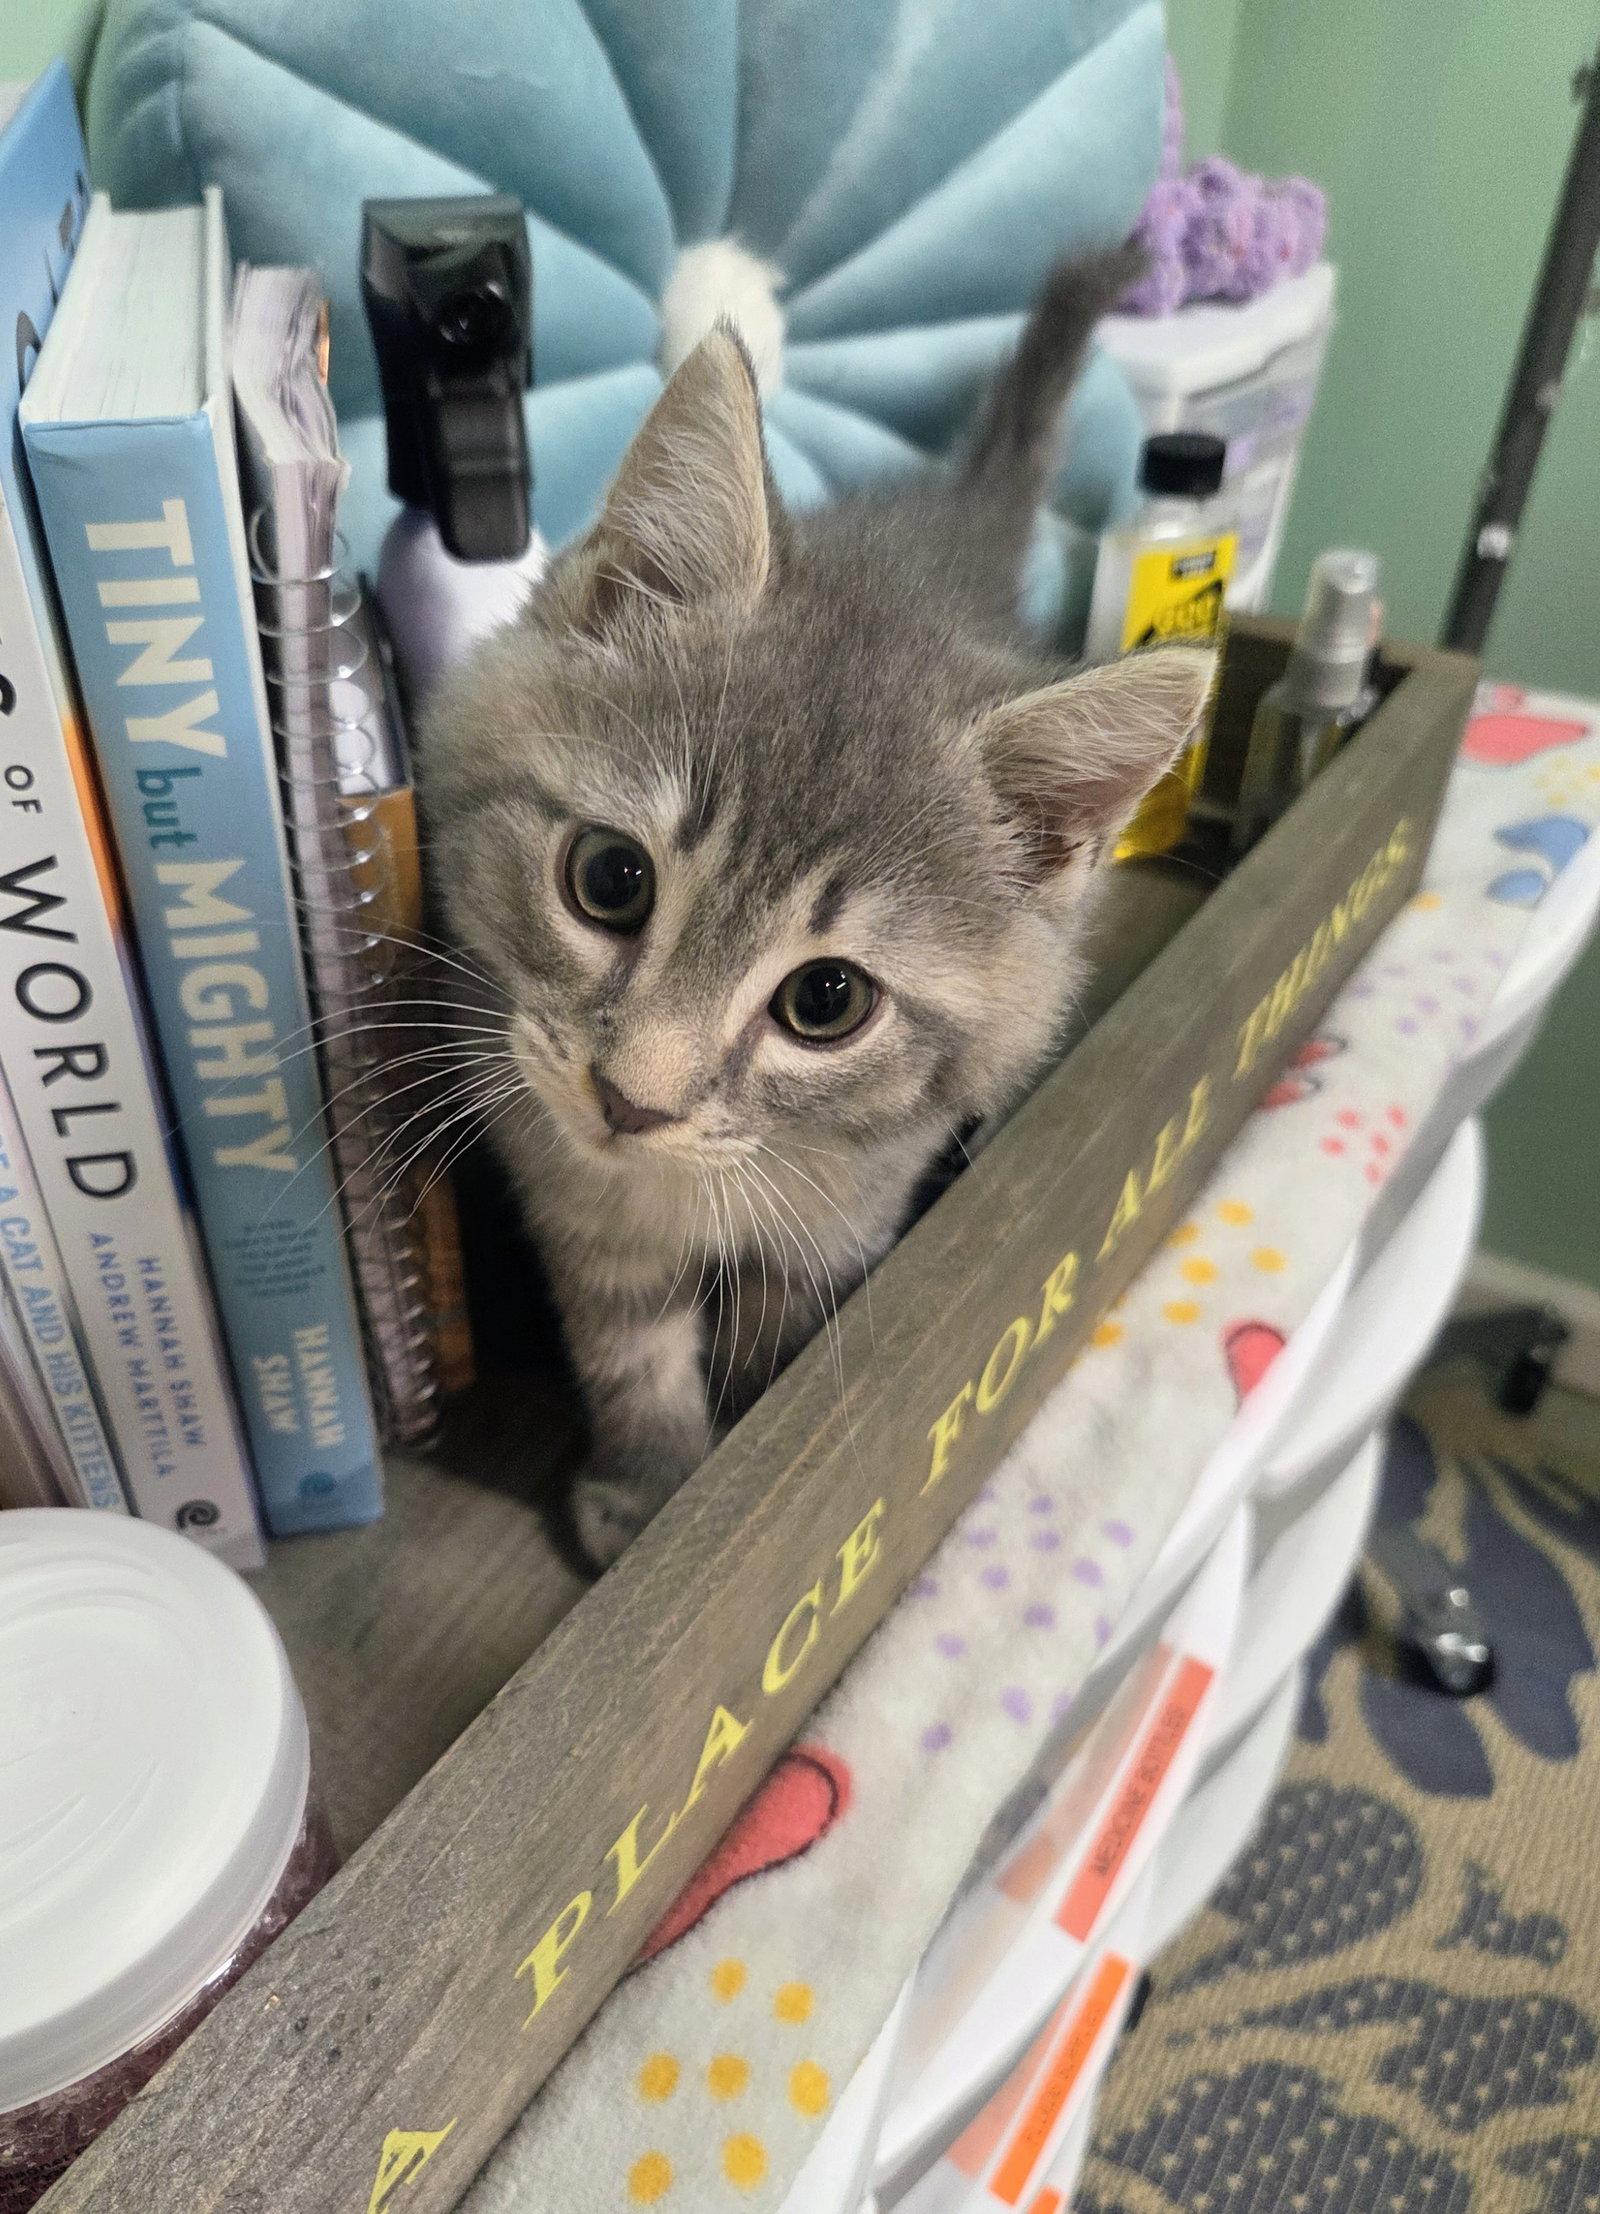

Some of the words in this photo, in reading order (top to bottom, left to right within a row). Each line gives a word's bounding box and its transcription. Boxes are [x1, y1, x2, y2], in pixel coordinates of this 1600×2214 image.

[85, 498, 228, 759] TINY
[4, 764, 44, 815] OF
[135, 765, 202, 849] but
[0, 853, 139, 1201] WORLD
[155, 858, 298, 1173] MIGHTY
[0, 1215, 44, 1272] CAT
[88, 1232, 141, 1349] ANDREW
[21, 1284, 67, 1344] AND
[137, 1255, 188, 1371] HANNAH
[169, 1380, 206, 1447] SHAW
[49, 1351, 84, 1397] HIS
[366, 2118, 459, 2214] A
[515, 1497, 888, 2031] PLACE
[919, 1251, 1079, 1496] FOR
[1097, 1074, 1210, 1263] ALL
